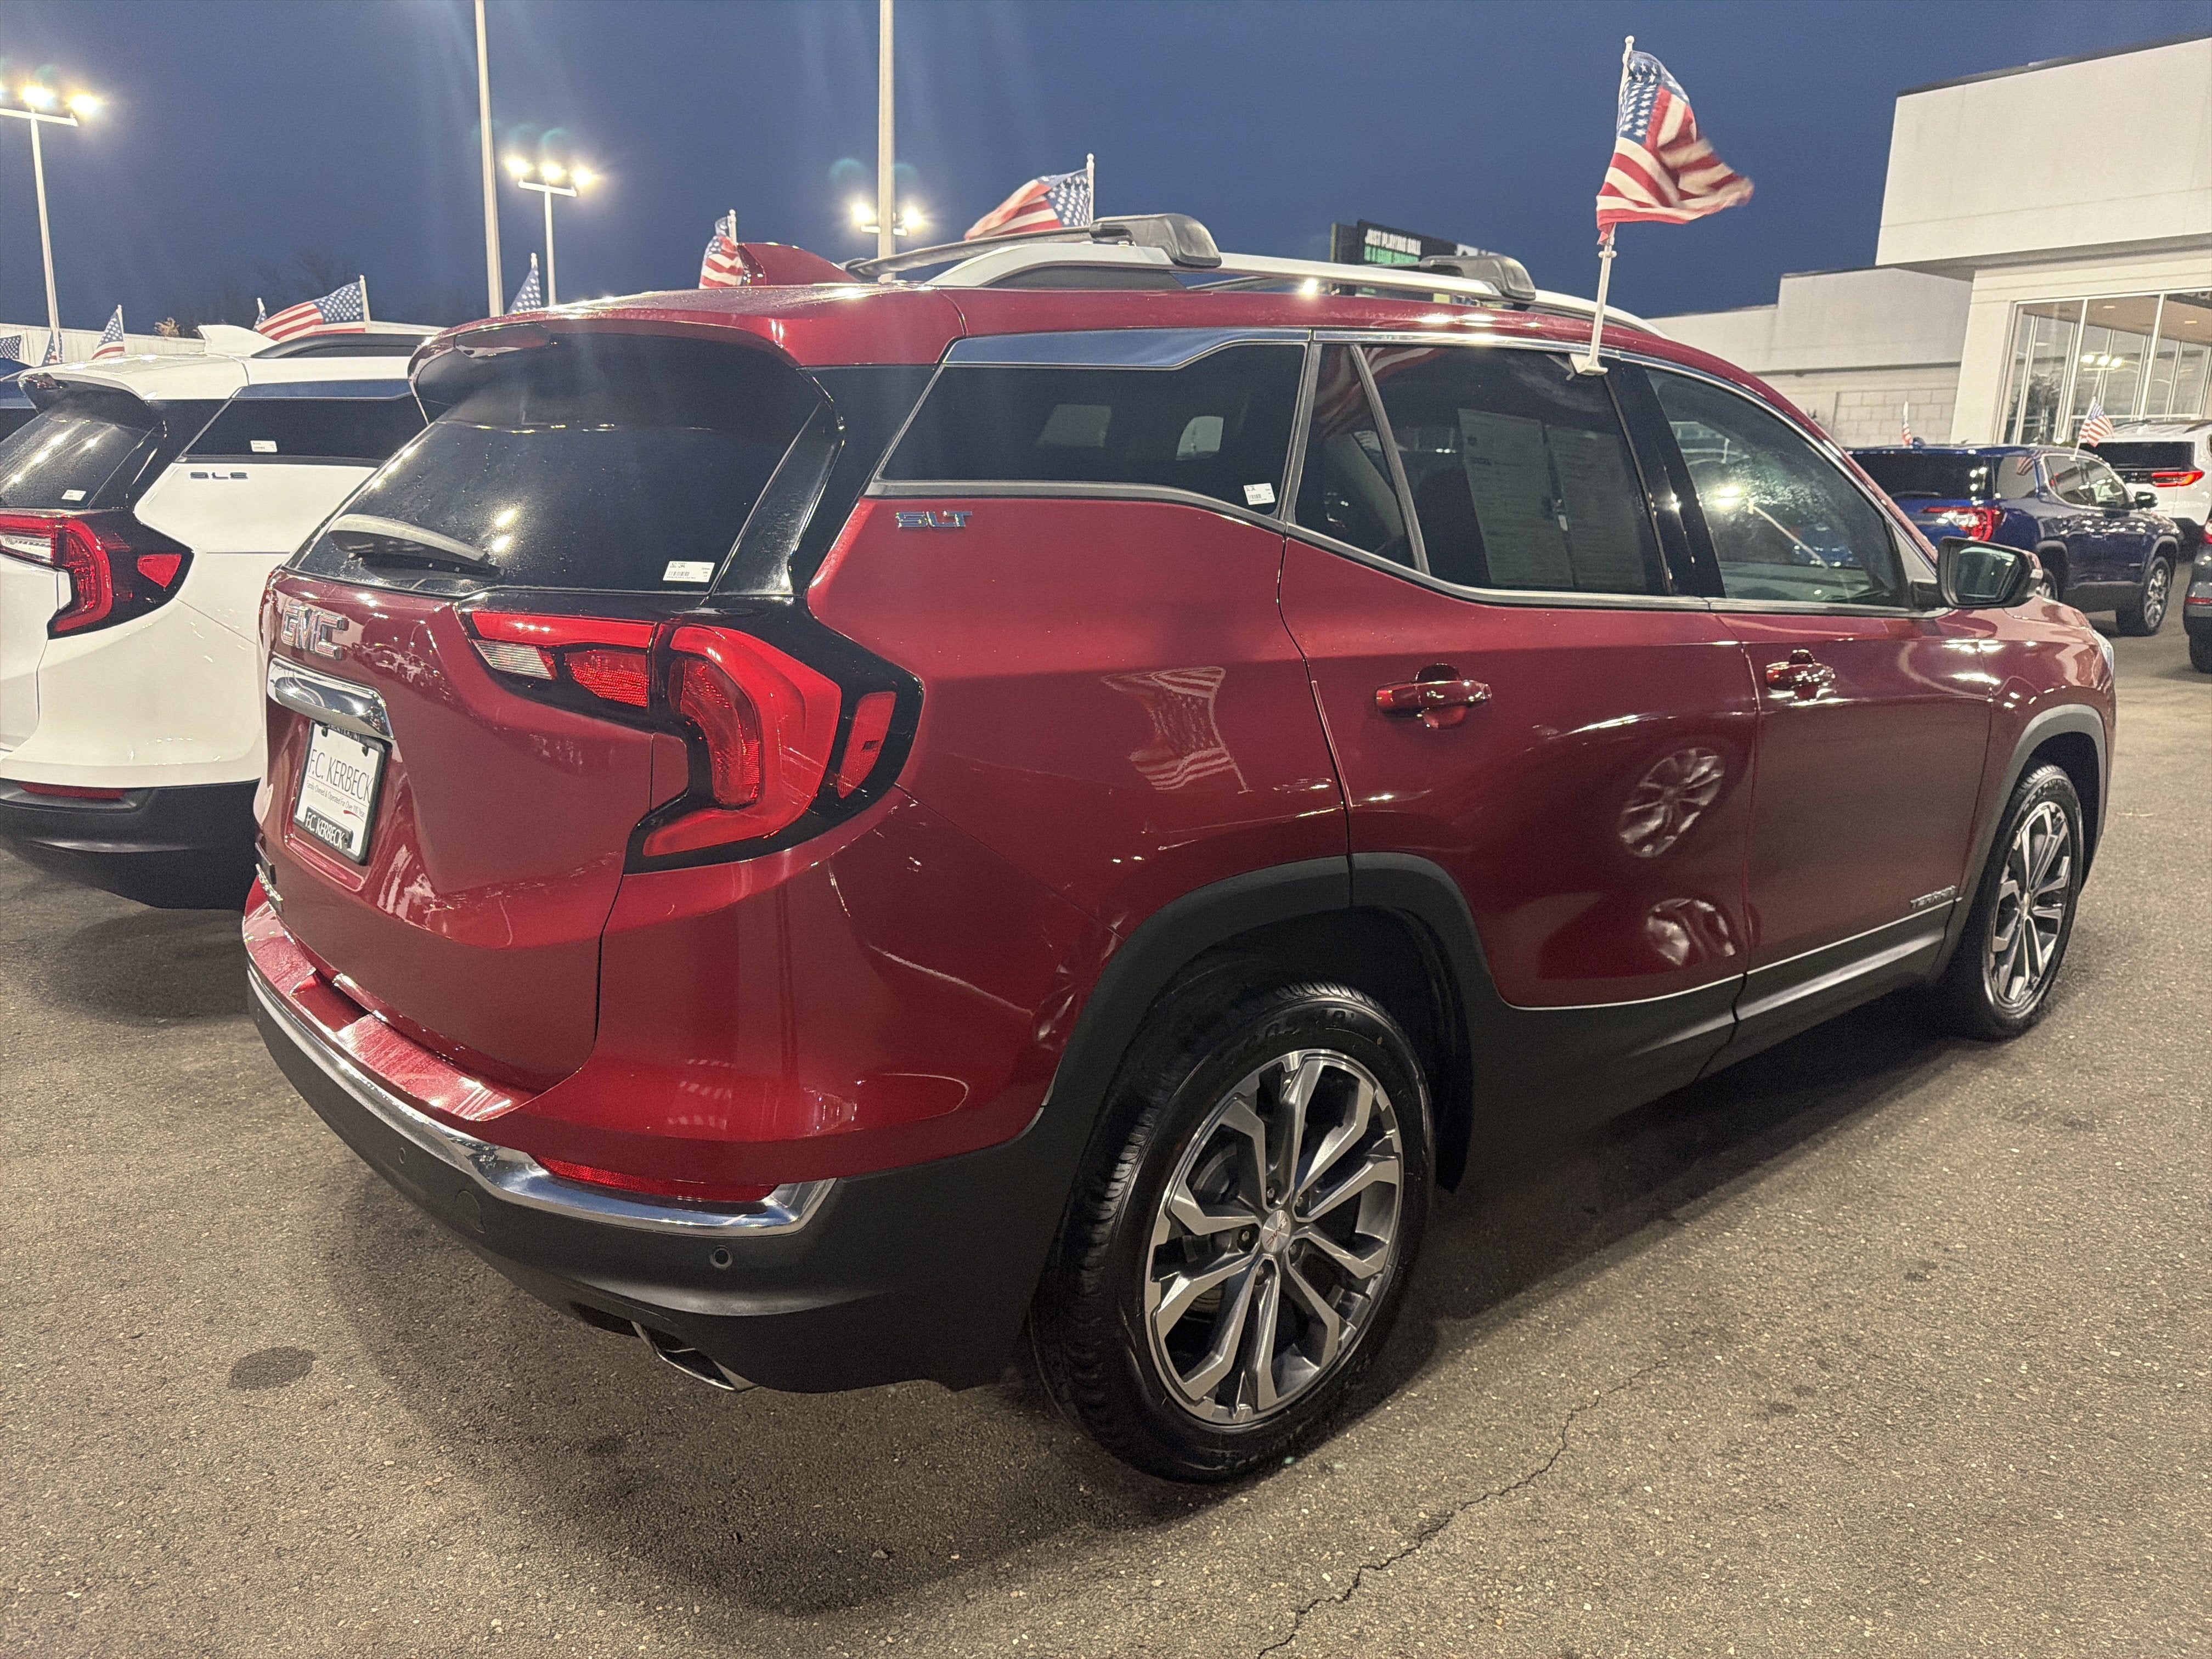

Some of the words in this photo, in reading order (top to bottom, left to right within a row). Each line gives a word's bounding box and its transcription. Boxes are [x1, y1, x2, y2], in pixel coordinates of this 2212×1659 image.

[190, 472, 249, 480] SLE
[895, 510, 973, 528] SLT
[281, 605, 349, 661] GMC
[308, 749, 325, 780] F.C.
[326, 757, 374, 804] KERBECK
[315, 817, 345, 849] KERBECK
[1266, 1217, 1288, 1246] GMC
